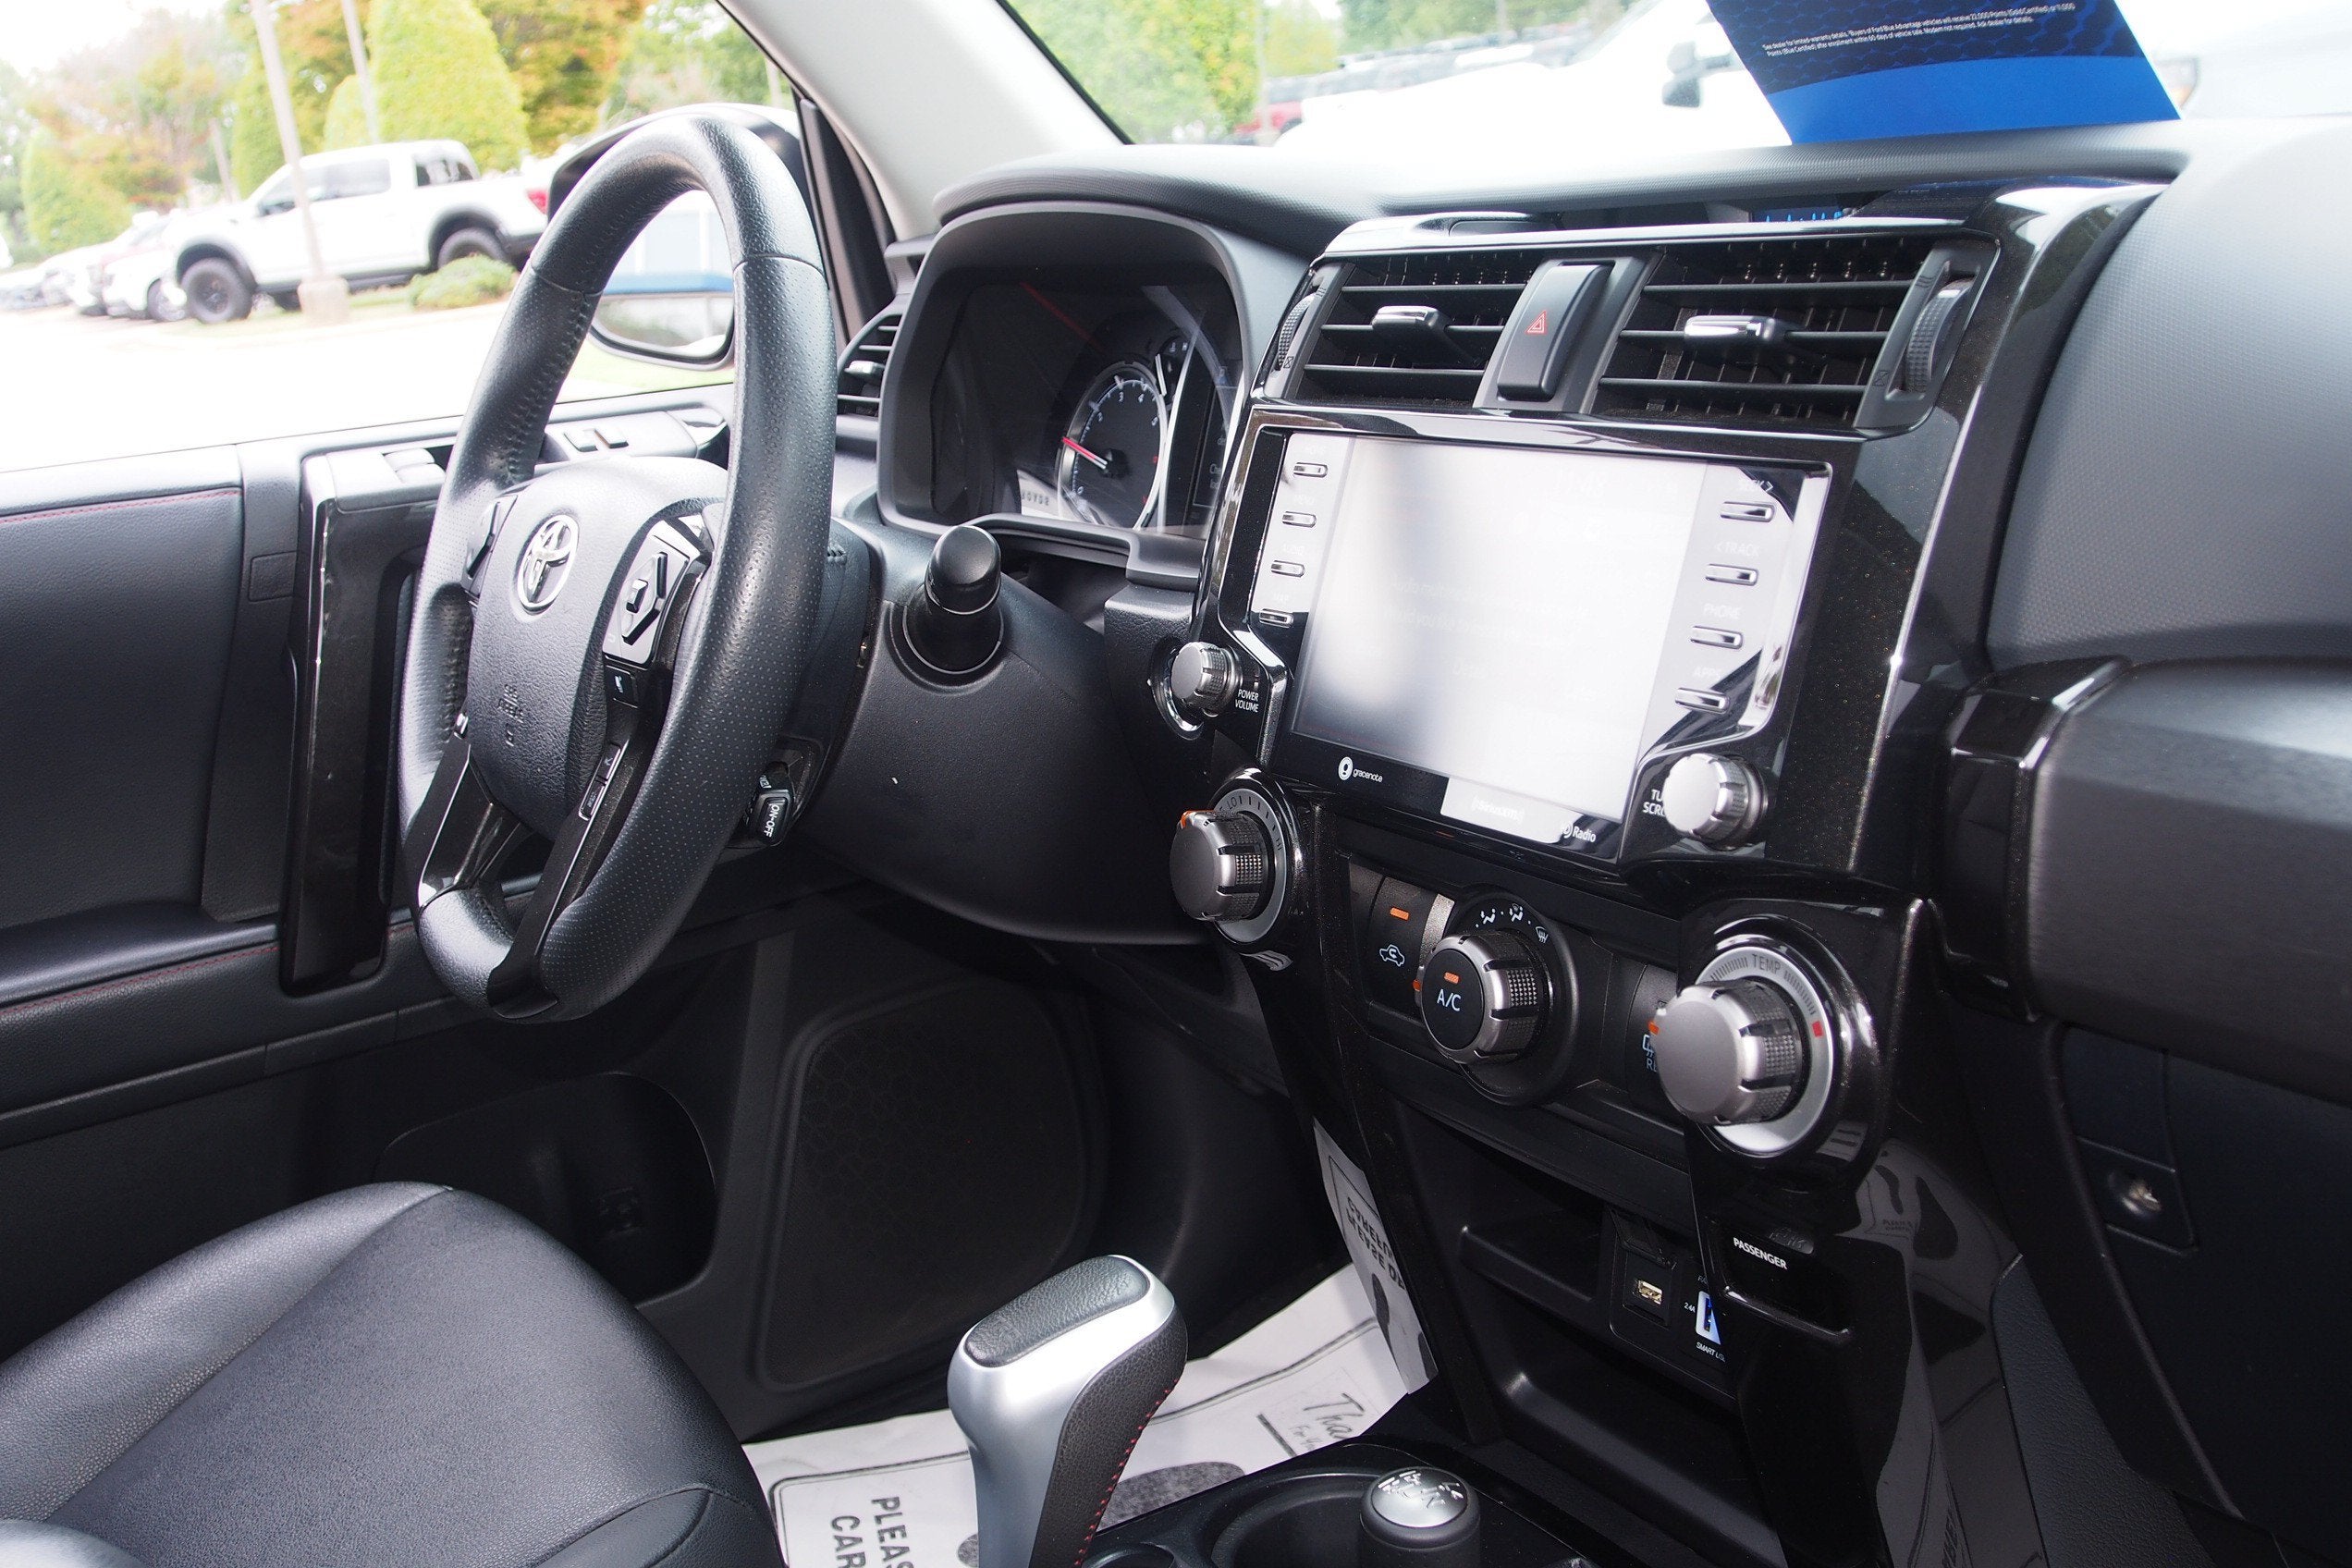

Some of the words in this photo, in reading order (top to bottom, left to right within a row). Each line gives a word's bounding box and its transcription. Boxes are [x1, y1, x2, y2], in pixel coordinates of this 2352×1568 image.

[1703, 603, 1742, 620] PHONE
[1237, 688, 1259, 702] POWER
[1235, 699, 1259, 713] VOLUME
[1353, 768, 1383, 782] gracenote
[1651, 789, 1663, 802] TU
[764, 803, 780, 838] ON-OFF
[1573, 826, 1597, 842] Radio
[1752, 953, 1781, 974] TEMP
[1437, 988, 1462, 1011] A/C
[1733, 1236, 1788, 1270] PASSENGER
[1696, 1341, 1716, 1357] SMART
